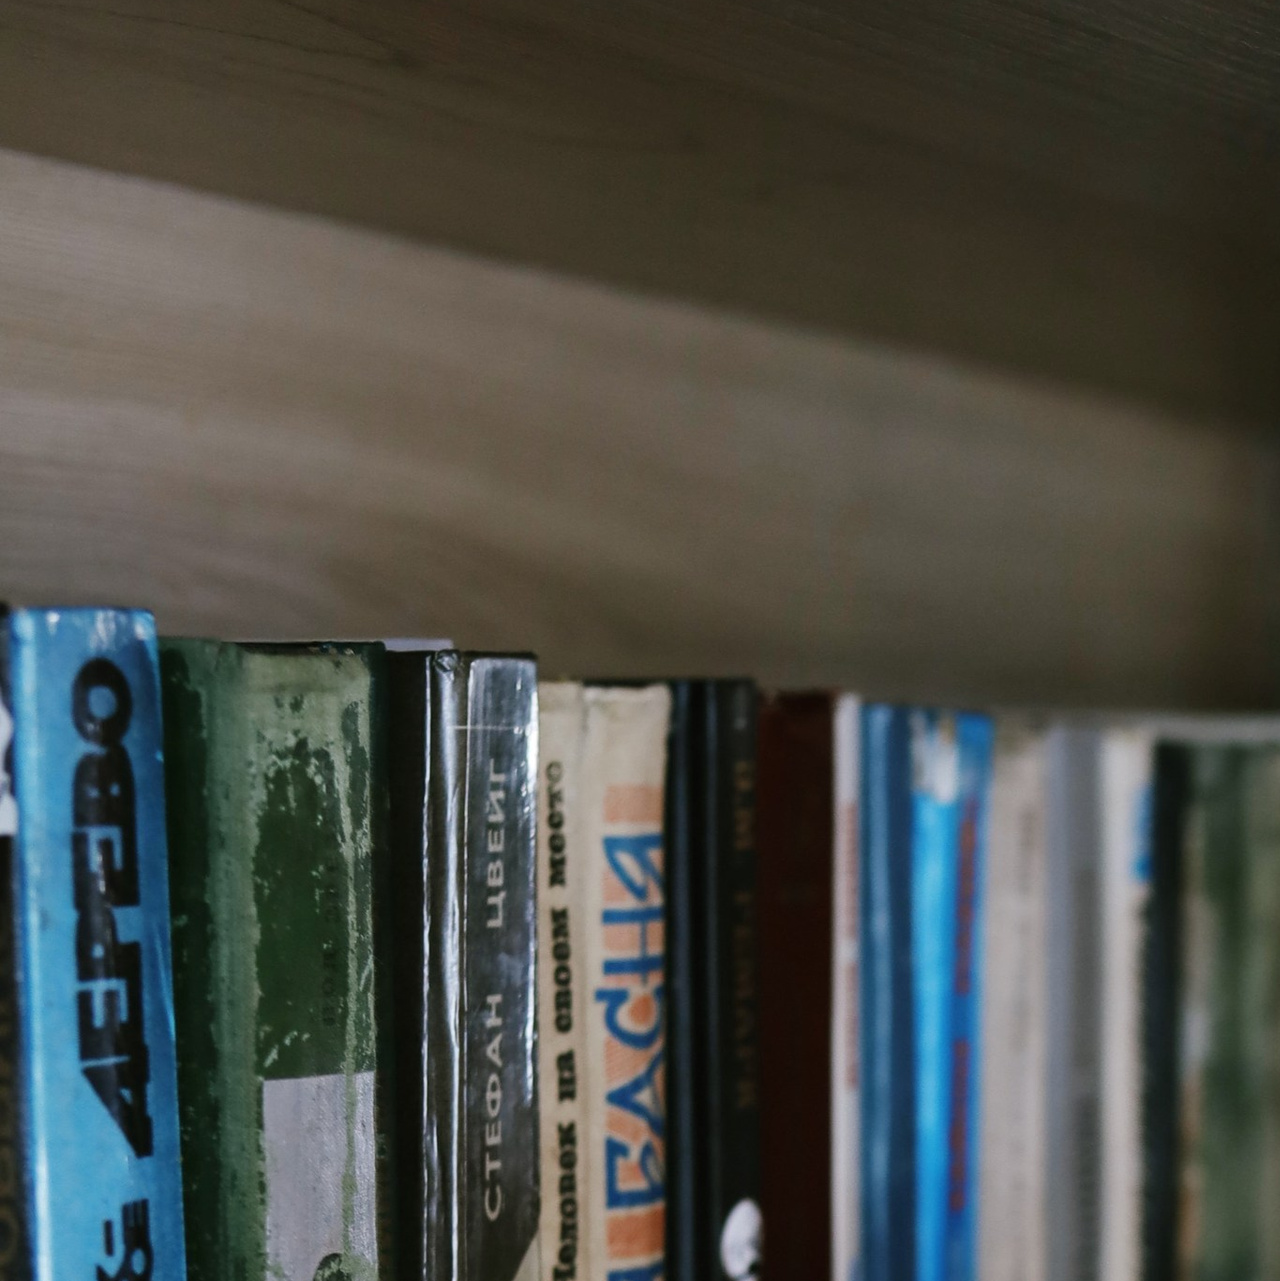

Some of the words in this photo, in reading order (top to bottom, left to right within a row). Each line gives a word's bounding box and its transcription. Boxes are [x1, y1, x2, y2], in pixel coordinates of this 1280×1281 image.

[71, 656, 153, 1158] ДЕРЕВО
[486, 757, 508, 929] ЦВЕЙГ
[544, 760, 568, 889] месте
[550, 906, 573, 1034] своем
[594, 832, 667, 1211] БАСНЯ
[484, 993, 504, 1222] СТЕФАН
[555, 1049, 578, 1103] на
